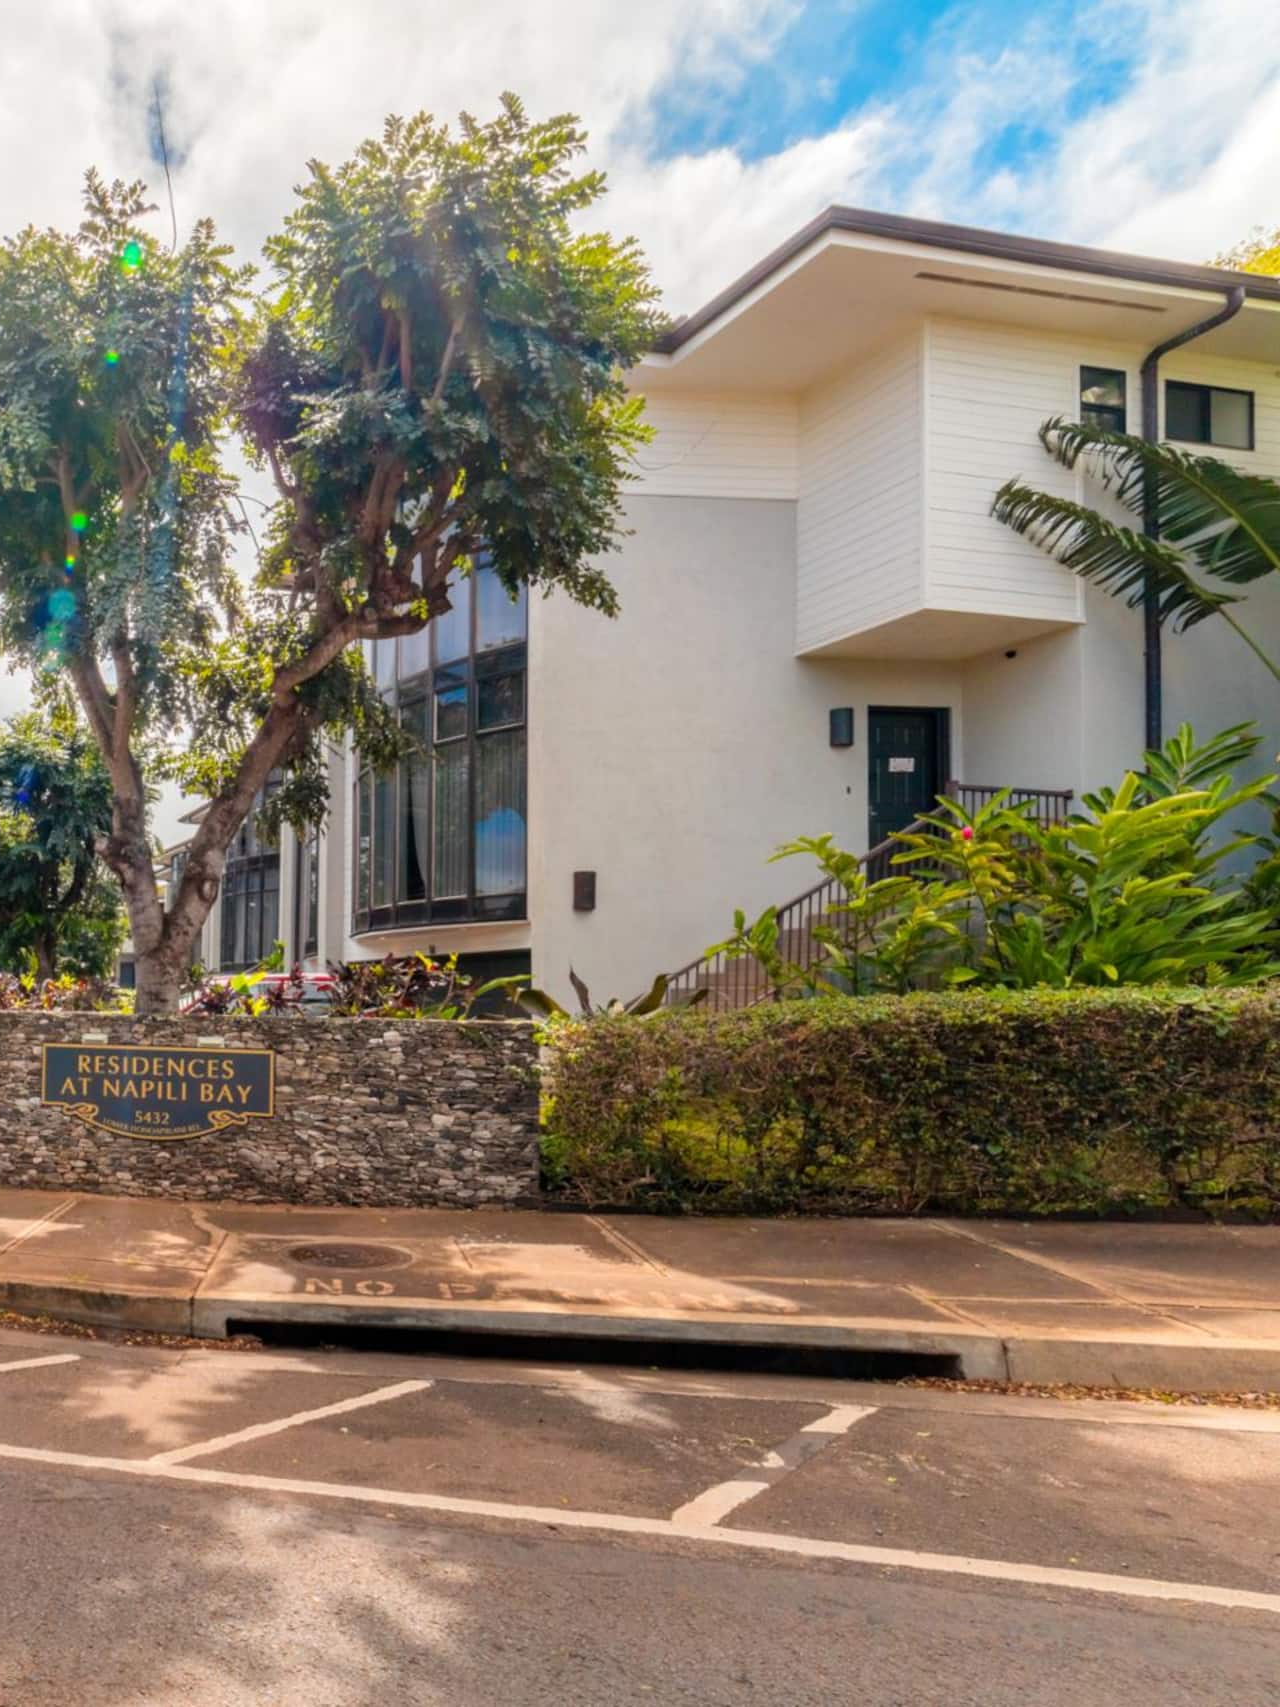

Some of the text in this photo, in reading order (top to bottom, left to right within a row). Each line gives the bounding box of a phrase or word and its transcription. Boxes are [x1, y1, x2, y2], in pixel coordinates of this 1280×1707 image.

[77, 1055, 235, 1080] RESIDENCES
[60, 1078, 252, 1104] AT NAPILI BAY
[134, 1110, 170, 1125] 5432
[304, 1277, 395, 1297] NO
